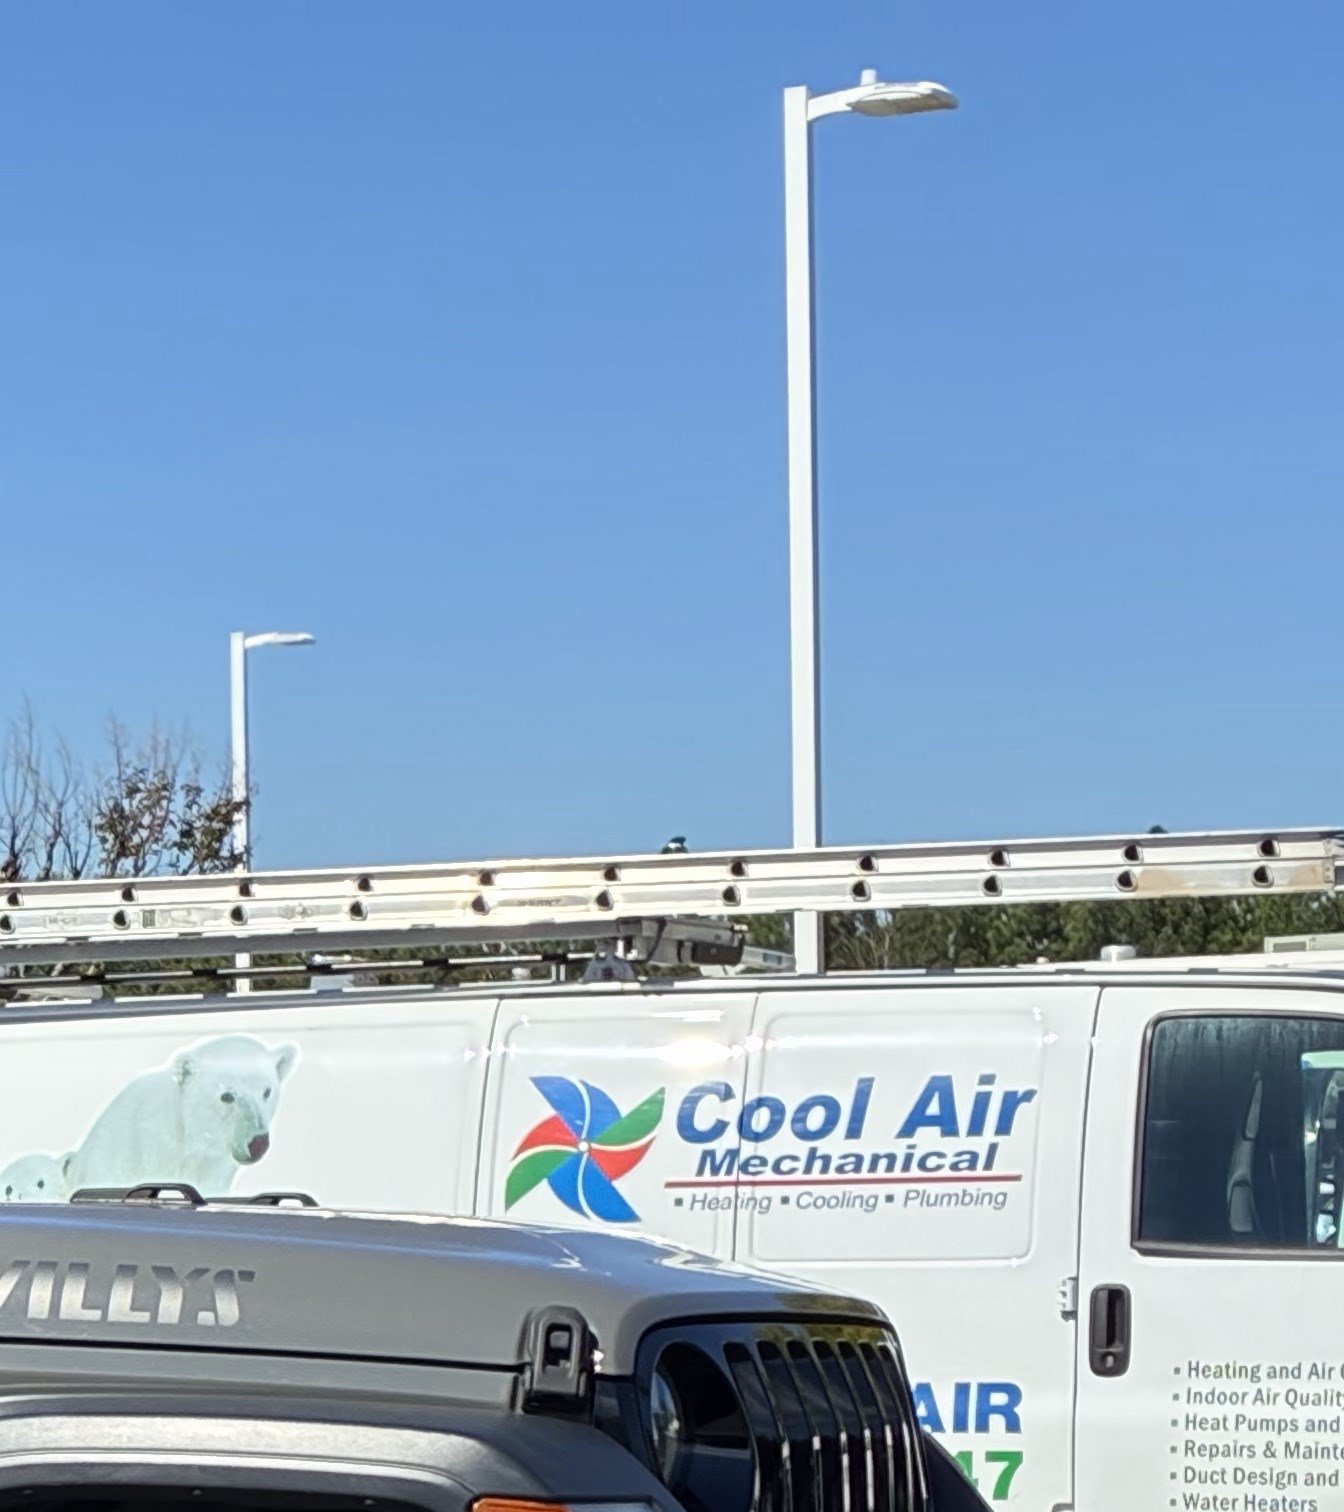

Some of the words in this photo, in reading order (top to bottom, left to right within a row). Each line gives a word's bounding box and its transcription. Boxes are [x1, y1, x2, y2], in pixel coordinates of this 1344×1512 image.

[676, 1076, 875, 1144] Cool
[894, 1073, 1038, 1139] Air
[695, 1143, 1000, 1177] Mechanical
[690, 1191, 772, 1214] Heating
[795, 1190, 879, 1213] Cooling
[903, 1188, 1008, 1211] Plumbing
[1188, 1360, 1261, 1384] Heating
[1266, 1362, 1302, 1380] and
[1307, 1362, 1336, 1381] Air
[1186, 1387, 1249, 1405] Indoor
[1252, 1388, 1281, 1406] Air
[1285, 1388, 1344, 1411] Qualit
[1184, 1412, 1229, 1432] Heat
[1234, 1413, 1299, 1436] Pumps
[1305, 1415, 1341, 1433] and
[1184, 1439, 1257, 1462] Repairs
[1263, 1440, 1278, 1459] &
[1183, 1465, 1228, 1485] Duct
[1233, 1467, 1298, 1490] Design
[1304, 1468, 1340, 1487] and
[1182, 1492, 1240, 1512] Water
[1244, 1493, 1318, 1512] Heaters
